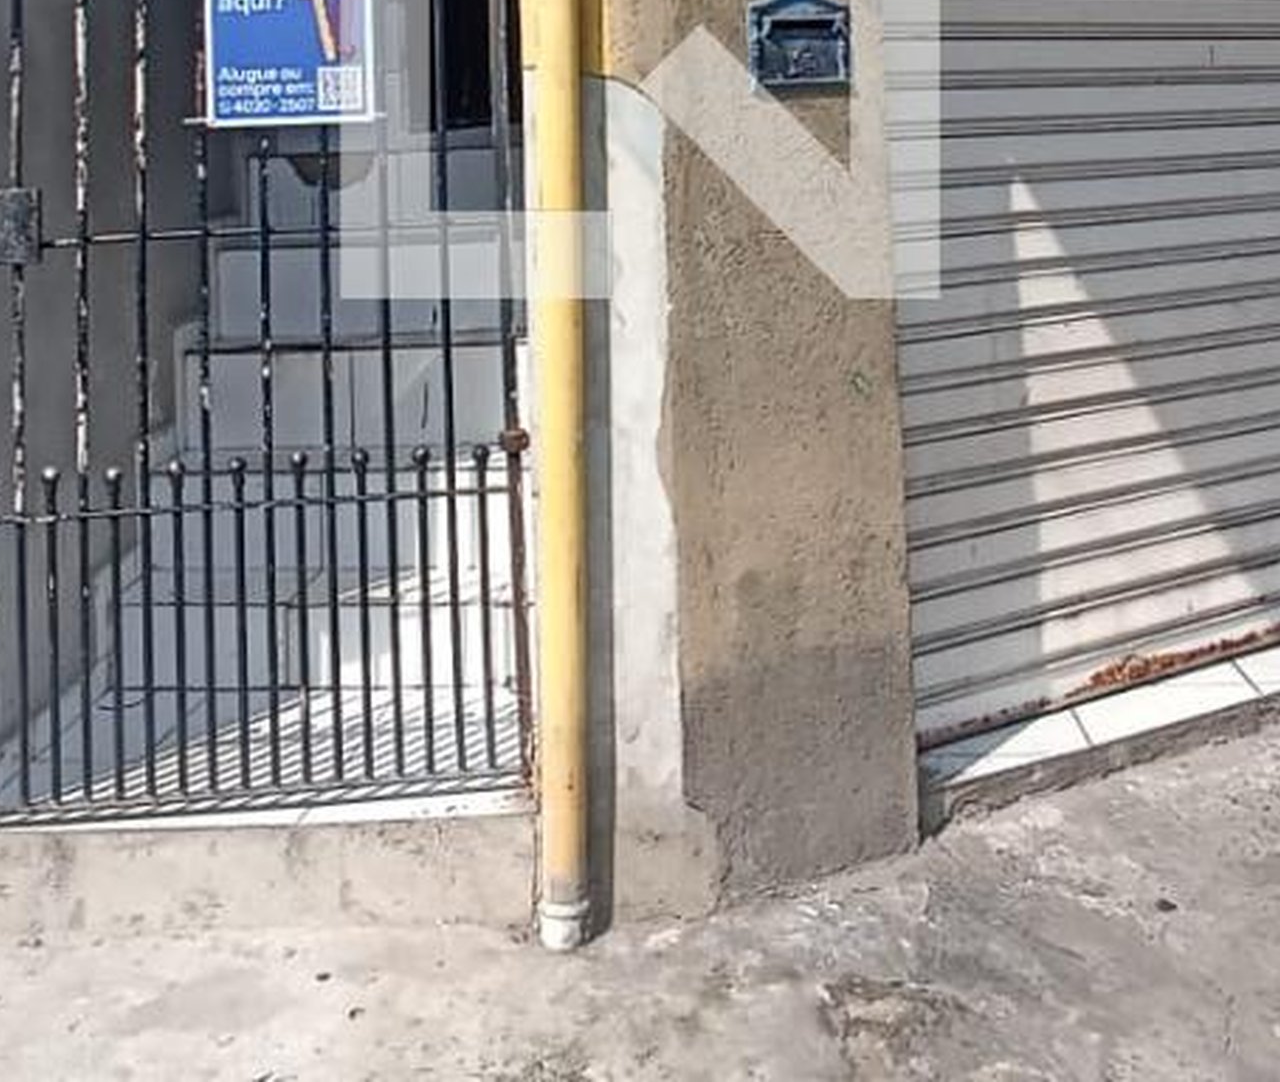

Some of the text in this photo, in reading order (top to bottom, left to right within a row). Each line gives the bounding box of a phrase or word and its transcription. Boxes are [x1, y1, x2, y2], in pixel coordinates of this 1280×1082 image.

[218, 66, 302, 83] Alugue ou
[218, 82, 282, 98] compre
